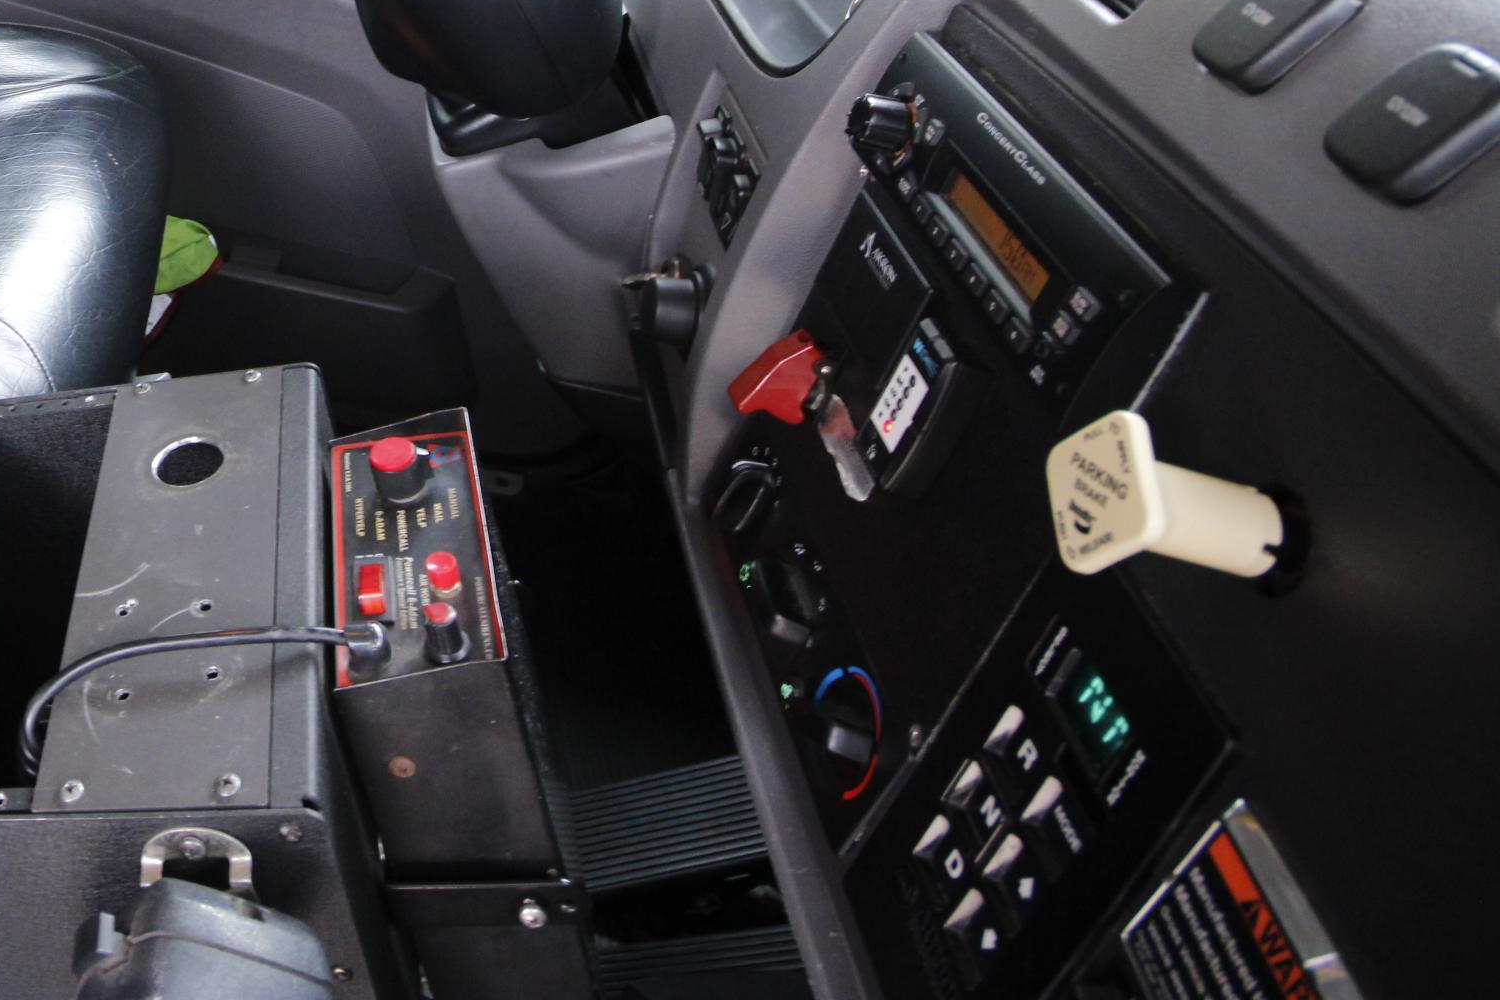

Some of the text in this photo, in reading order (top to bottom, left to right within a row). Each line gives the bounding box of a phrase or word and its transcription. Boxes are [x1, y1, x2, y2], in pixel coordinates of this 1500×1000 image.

[1070, 451, 1129, 501] PARKING
[355, 498, 366, 537] HYPERYELP
[416, 507, 428, 529] YELP
[433, 503, 445, 524] WAIL
[447, 487, 461, 520] MANUAL
[396, 509, 409, 553] POWERCALL
[404, 556, 418, 596] Powercall
[419, 573, 429, 587] AIR
[1017, 738, 1039, 771] R
[980, 794, 1001, 828] N
[1054, 804, 1083, 853] MODE
[944, 848, 964, 879] D
